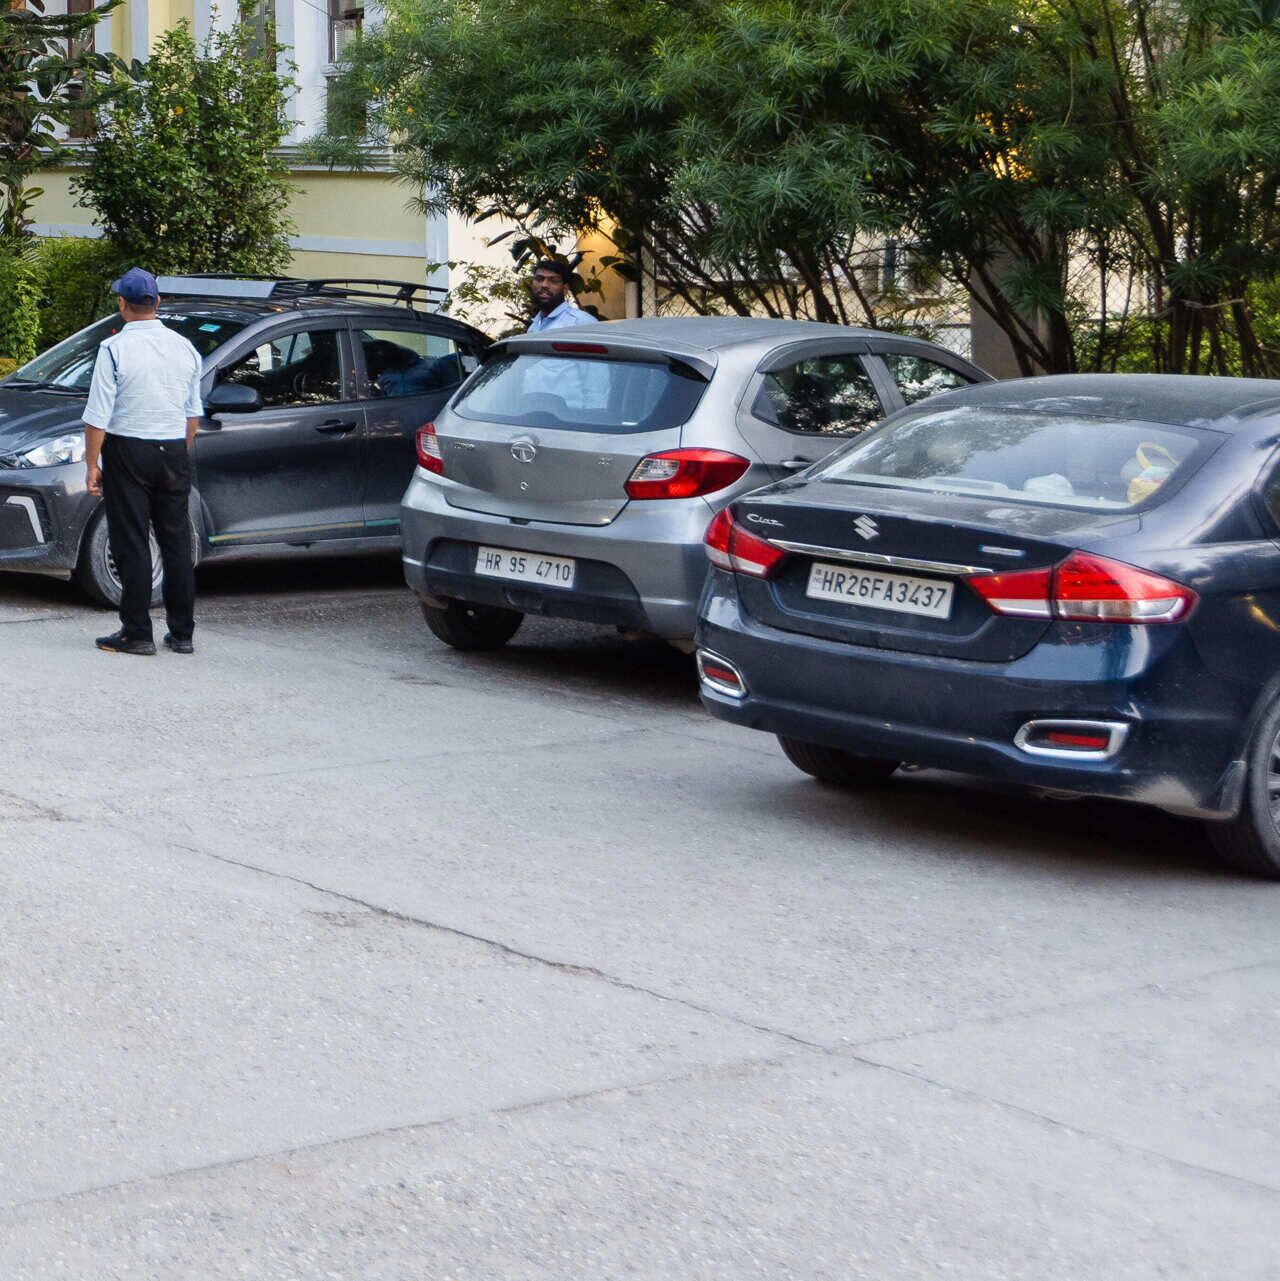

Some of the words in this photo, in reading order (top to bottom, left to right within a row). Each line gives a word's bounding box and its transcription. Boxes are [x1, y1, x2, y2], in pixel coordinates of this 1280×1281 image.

[485, 552, 502, 571] HR
[509, 556, 527, 574] 95
[535, 559, 571, 581] 4710
[822, 570, 948, 609] HR26FA3437
